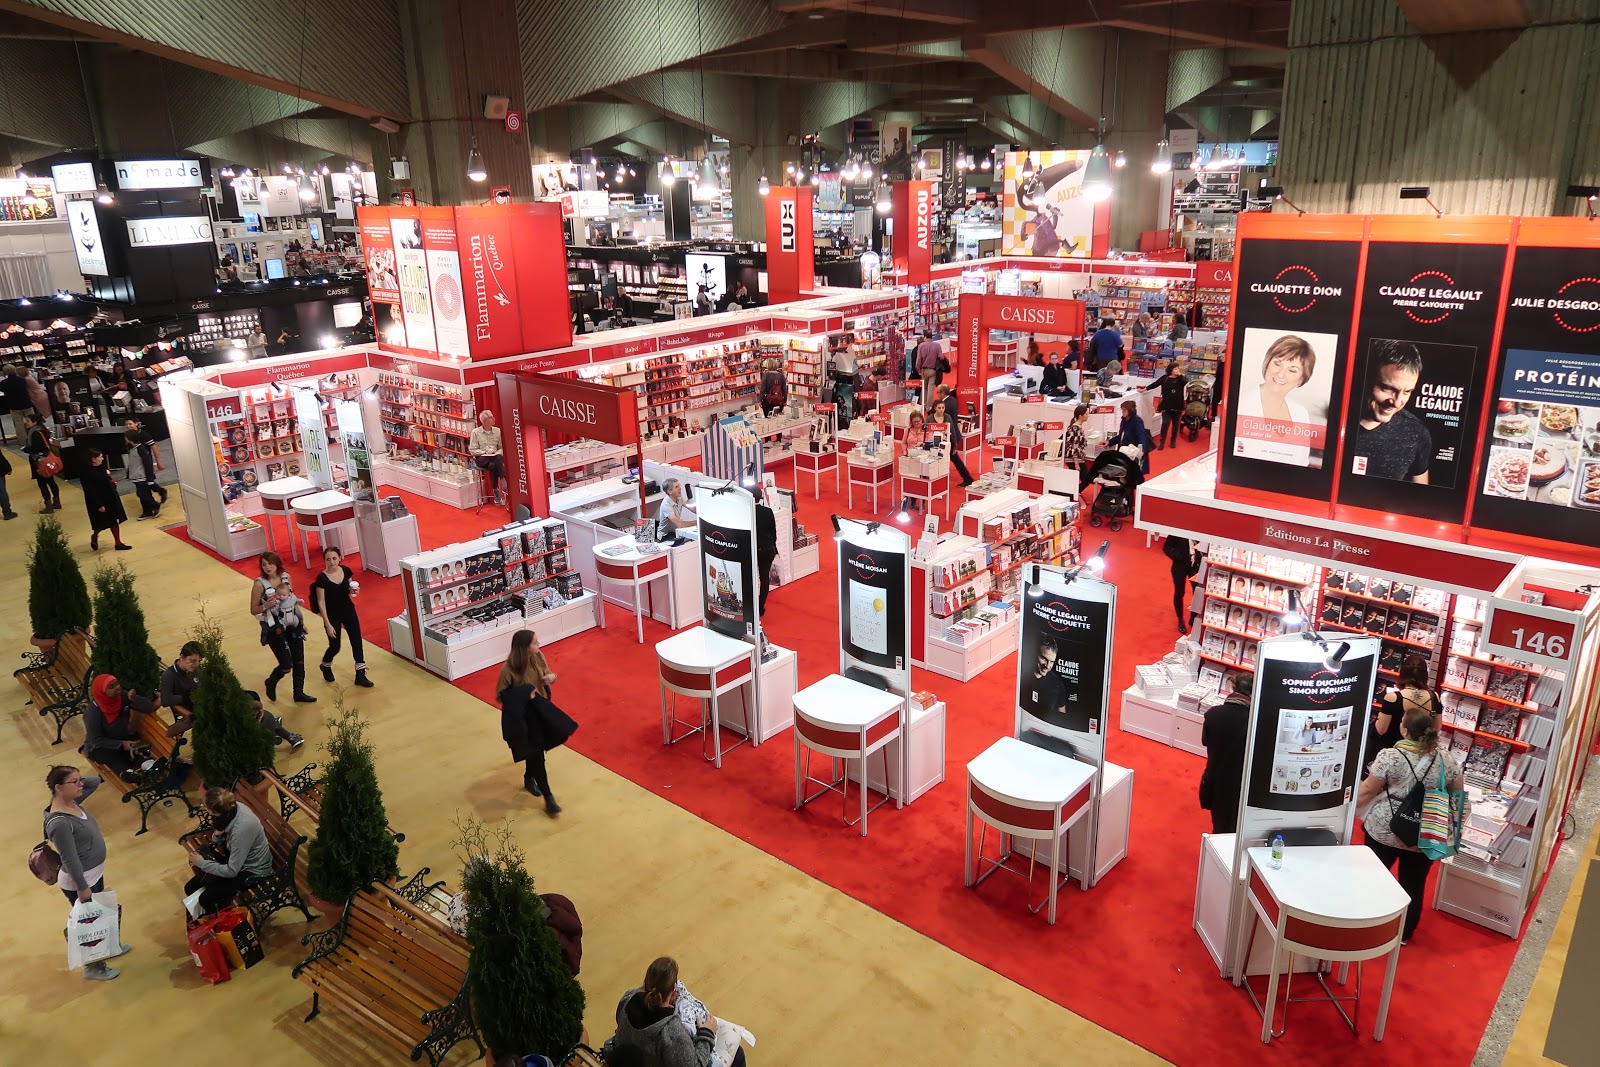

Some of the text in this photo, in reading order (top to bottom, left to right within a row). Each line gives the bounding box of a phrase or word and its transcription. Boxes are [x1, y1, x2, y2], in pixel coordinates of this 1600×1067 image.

[918, 190, 928, 250] AUZOU
[782, 204, 794, 250] LUX
[326, 288, 350, 296] CAISSE
[470, 234, 504, 342] Flammarion Québec
[1250, 283, 1342, 296] CLAUDETTE DION
[1379, 286, 1483, 302] CLAUDE LEGAULT
[1392, 299, 1464, 310] PIERRE CAYOUETTE
[1511, 298, 1546, 308] JULIE
[1000, 306, 1056, 324] CAISSE
[708, 330, 725, 338] Rivages
[968, 316, 980, 378] Flammarion
[266, 362, 311, 374] Flammarion
[520, 360, 555, 370] Louise Penny
[277, 370, 305, 381] Québec
[1421, 383, 1465, 400] CLAUDE
[540, 394, 597, 425] CAISSE
[1415, 396, 1462, 412] LEGAULT
[208, 405, 233, 418] 146
[1426, 412, 1460, 422] IMPROVISATIONS
[1242, 419, 1318, 438] Claudette Dion
[512, 408, 528, 495] Flammarion
[715, 539, 738, 548] CHAPLEAU
[1265, 526, 1370, 556] Éditions La Presse
[865, 565, 888, 574] MOISAN
[1035, 602, 1088, 622] CLAUDE LEGAULT
[1032, 608, 1091, 630] PIERRE CAYOUETTE
[1512, 628, 1565, 657] 146
[1056, 664, 1079, 676] LEGAULT
[1058, 658, 1080, 670] CLAUDE
[1448, 669, 1466, 679] USA
[1282, 676, 1358, 688] SOPHIE DUCHARME
[1289, 684, 1352, 695] SIMON PÉRUSSE
